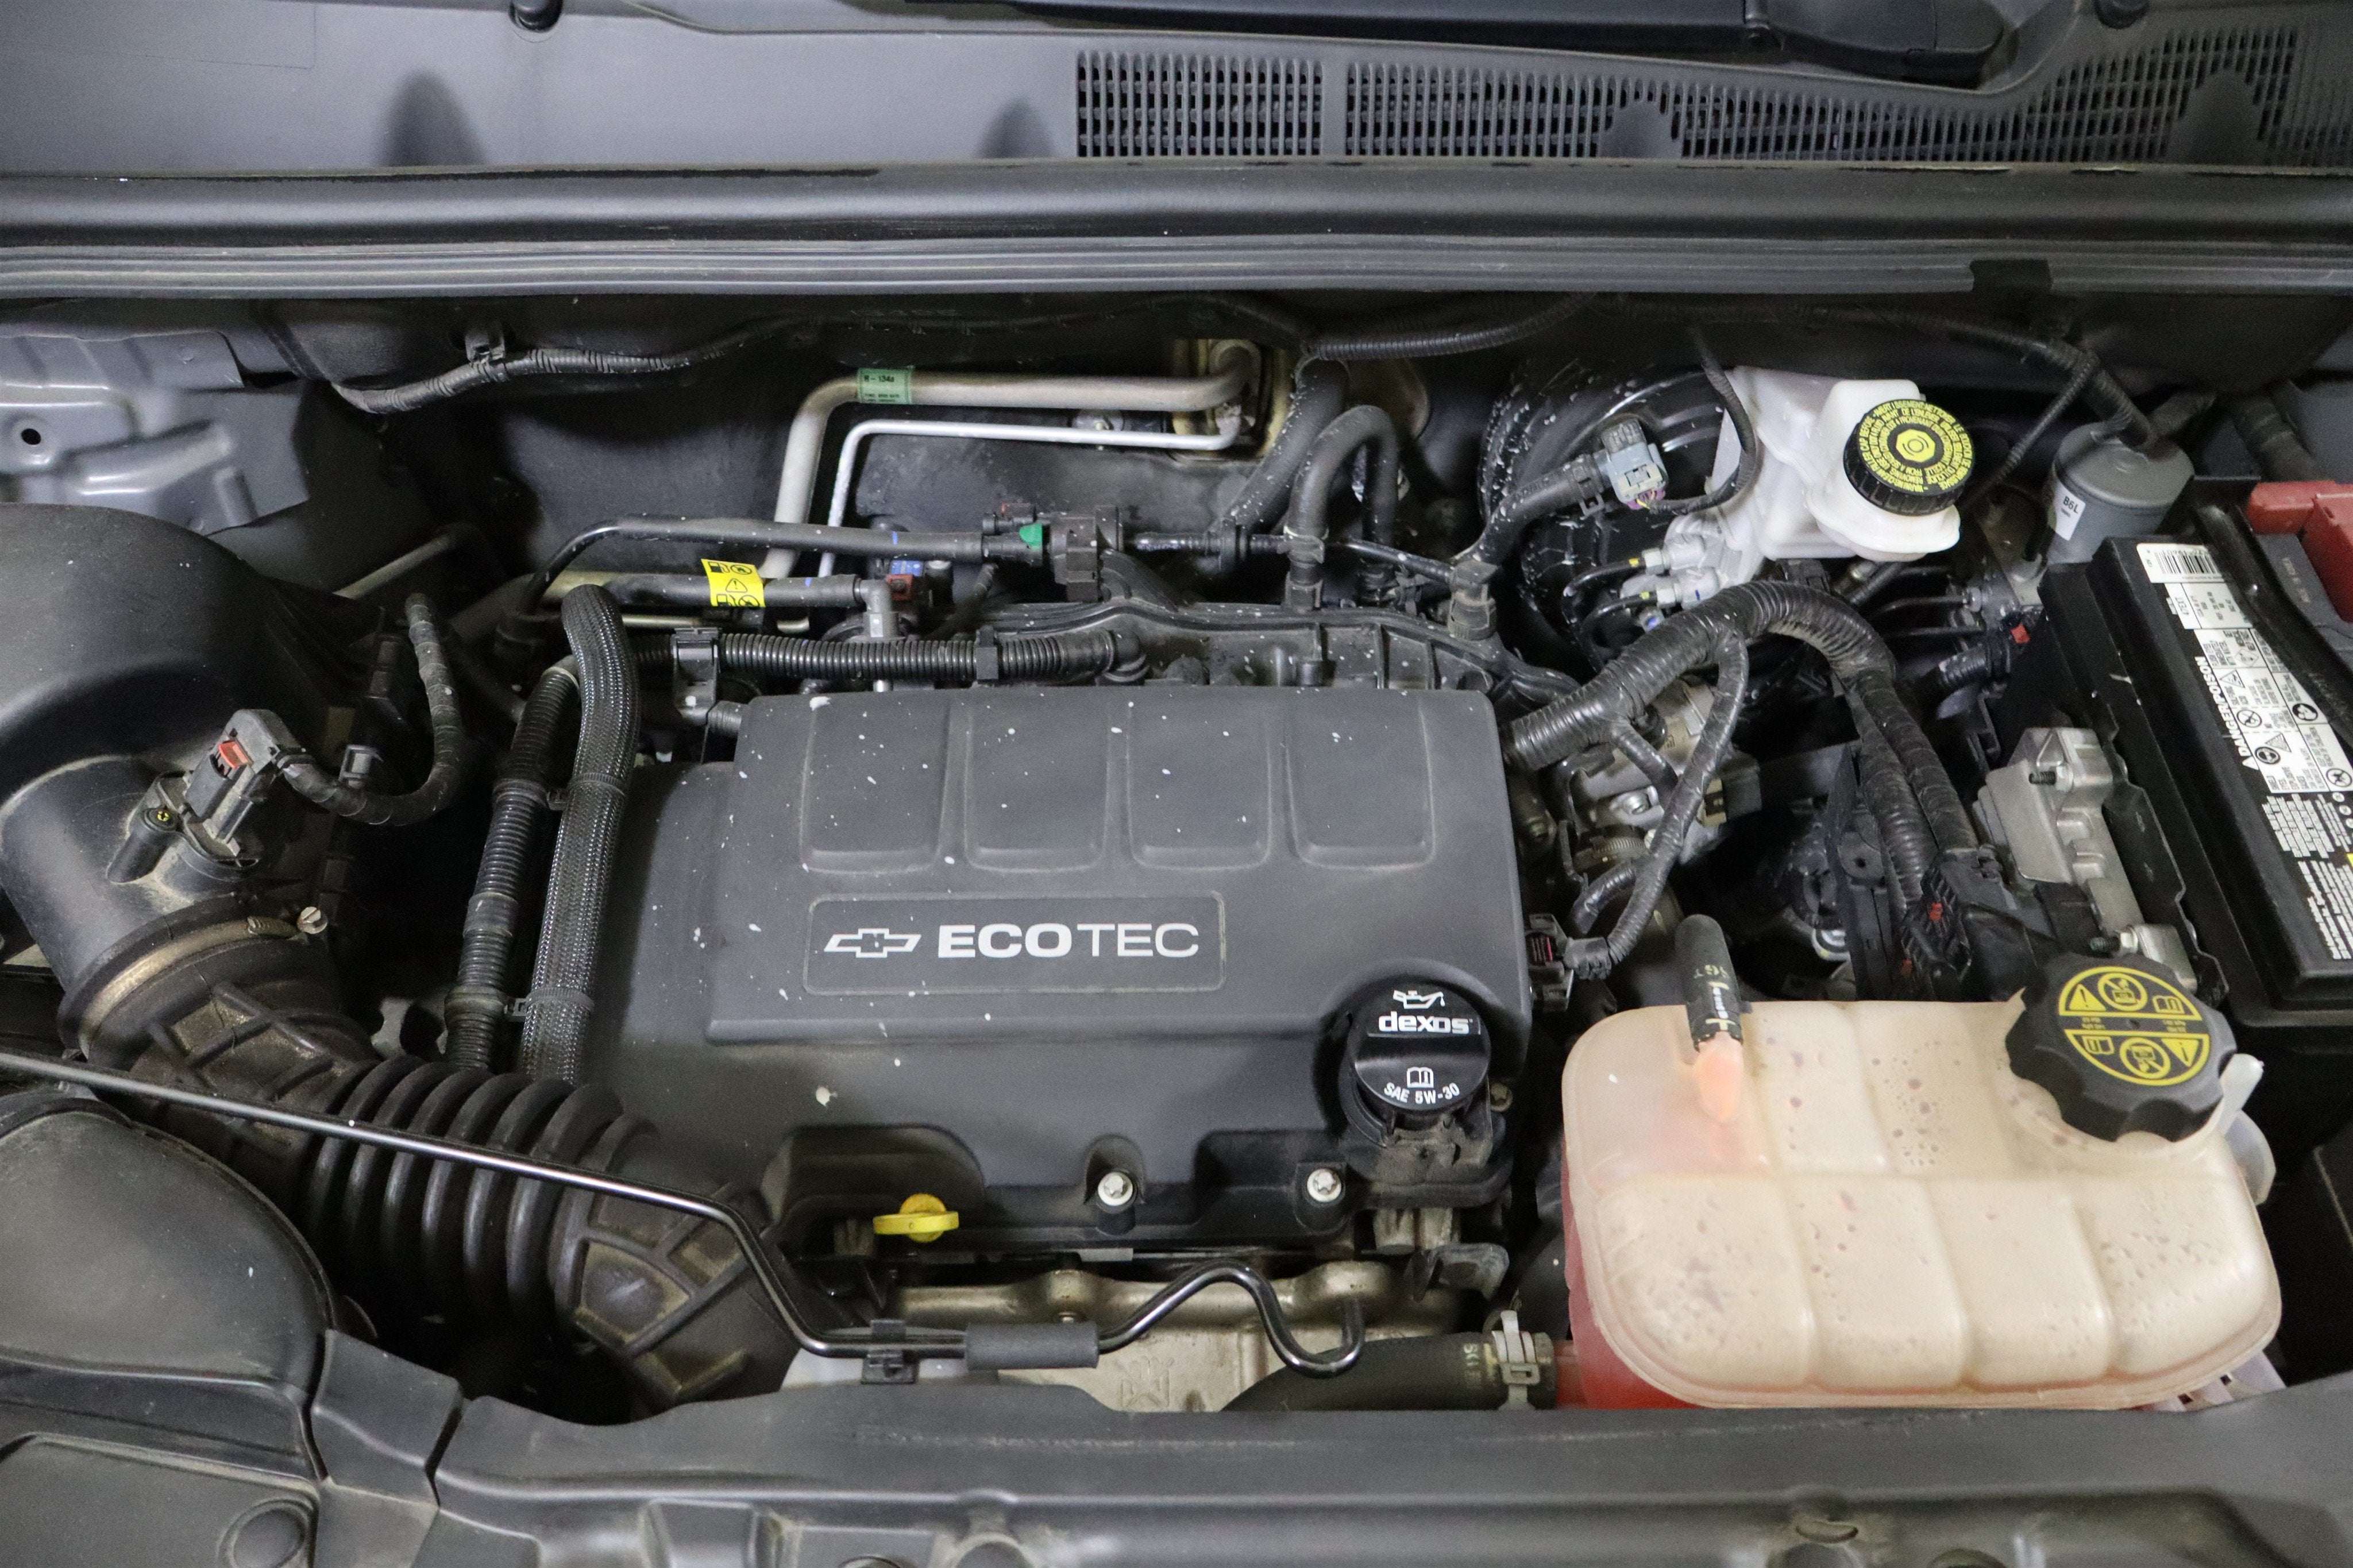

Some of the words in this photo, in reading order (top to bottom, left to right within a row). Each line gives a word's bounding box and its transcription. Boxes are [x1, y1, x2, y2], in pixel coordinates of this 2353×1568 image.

[1860, 416, 1874, 436] BEFORE
[1860, 438, 1869, 450] CAP
[1905, 467, 1922, 475] FROM
[2194, 656, 2252, 757] DANGER/POISON
[938, 923, 1199, 959] ECOTEC
[1384, 1083, 1410, 1103] SAE
[1415, 1083, 1460, 1104] 5W-30
